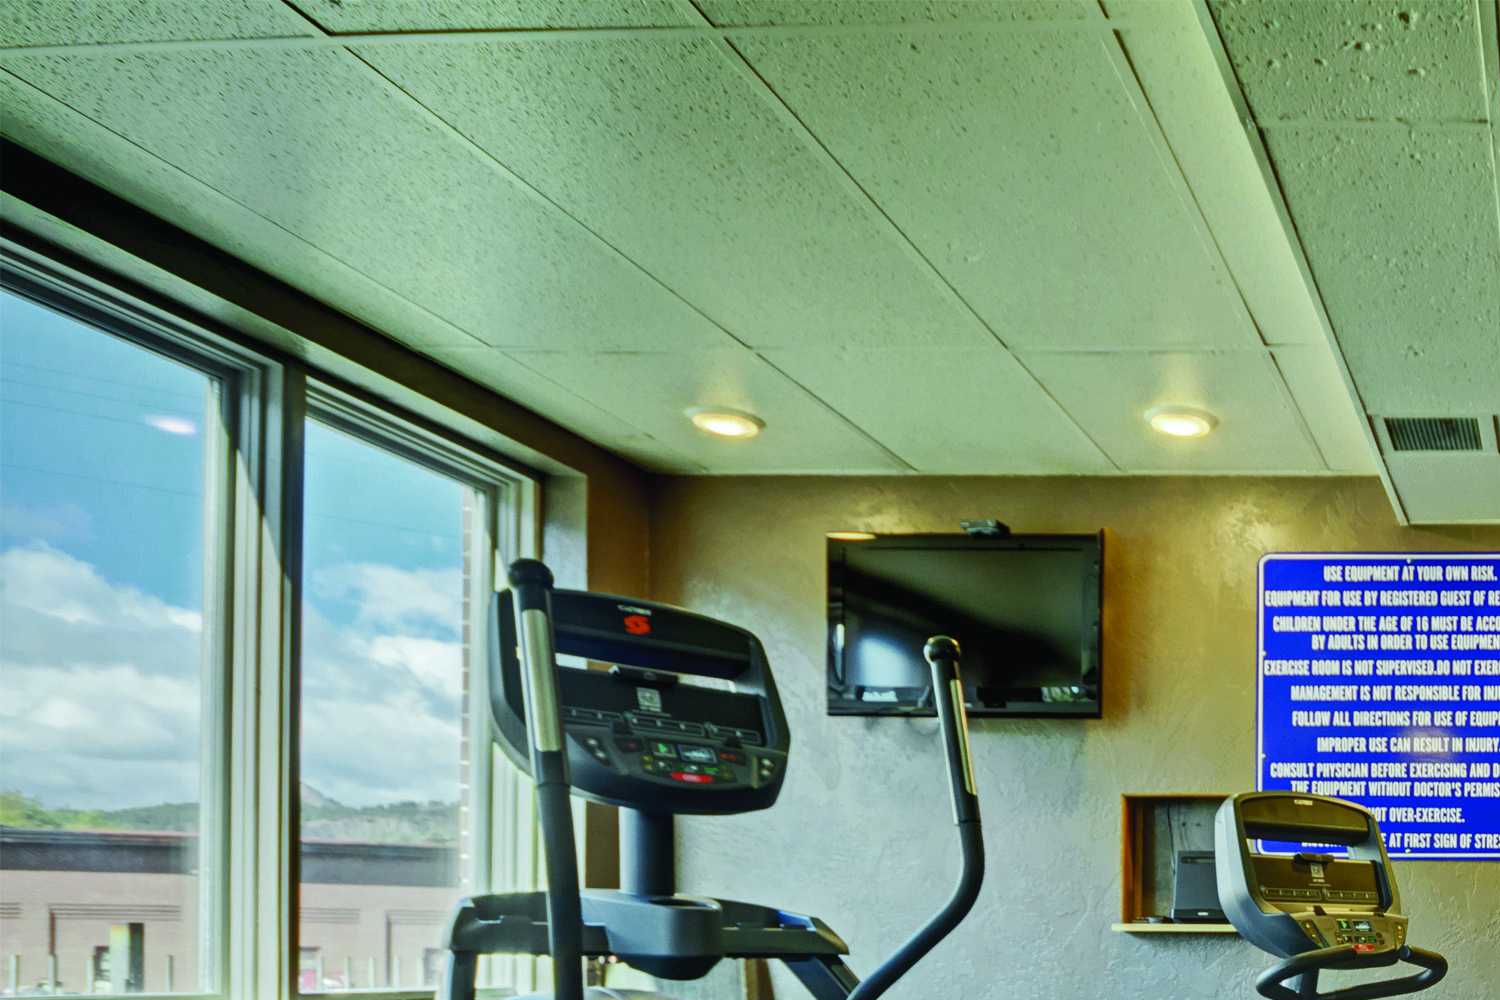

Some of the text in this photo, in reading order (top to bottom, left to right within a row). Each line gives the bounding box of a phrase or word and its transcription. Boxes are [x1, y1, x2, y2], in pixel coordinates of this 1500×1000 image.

[1324, 566, 1497, 581] USE EQUIPMENT AT YOUR OWN RISK.
[1265, 590, 1320, 606] EQUIPMENT
[1322, 590, 1341, 606] FOR
[1343, 590, 1362, 606] USE
[1364, 591, 1378, 606] BY
[1380, 591, 1438, 606] REGISTERED
[1440, 591, 1471, 606] GUEST
[1473, 590, 1485, 606] OF
[1273, 616, 1321, 632] CHILDREN
[1323, 616, 1356, 632] UNDER
[1358, 616, 1376, 631] THE
[1379, 616, 1398, 631] AGE
[1400, 616, 1413, 631] OF
[1416, 616, 1429, 631] 16
[1431, 616, 1458, 631] MUST
[1460, 616, 1473, 631] BE
[1312, 634, 1326, 650] BY
[1328, 634, 1365, 650] ADULTS
[1367, 635, 1378, 650] IN
[1380, 634, 1412, 650] ORDER
[1415, 634, 1427, 650] TO
[1430, 634, 1449, 650] USE
[1264, 660, 1310, 676] EXERCISE
[1312, 660, 1340, 675] ROOM
[1342, 660, 1352, 675] IS
[1354, 660, 1374, 675] NOT
[1452, 660, 1472, 675] NOT
[1291, 685, 1358, 701] MANAGEMENT
[1360, 685, 1370, 701] IS
[1373, 685, 1392, 701] NOT
[1395, 685, 1460, 701] RESPONSIBLE
[1462, 685, 1481, 701] FOR
[1292, 711, 1331, 726] FOLLOW
[1333, 711, 1351, 726] ALL
[1353, 711, 1410, 726] DIRECTIONS
[1412, 711, 1431, 727] FOR
[1434, 711, 1453, 726] USE
[1455, 711, 1468, 726] OF
[1317, 737, 1366, 752] IMPROPER
[1369, 737, 1388, 752] USE
[1390, 737, 1410, 752] CAN
[1413, 737, 1449, 752] RESULT
[1452, 737, 1463, 752] IN
[1270, 763, 1314, 778] CONSULT
[1316, 763, 1368, 778] PHYSICIAN
[1371, 763, 1407, 778] BEFORE
[1410, 762, 1467, 778] EXERCISING
[1470, 763, 1490, 778] AND
[1291, 781, 1309, 793] THE
[1312, 781, 1366, 796] EQUIPMENT
[1368, 781, 1411, 796] WITHOUT
[1414, 782, 1461, 797] DOCTOR'S
[1389, 807, 1465, 822] OVER-EXERCISE.
[1389, 833, 1402, 847] AT
[1404, 833, 1431, 848] FIRST
[1434, 833, 1457, 848] SIGN
[1460, 834, 1472, 848] OF
